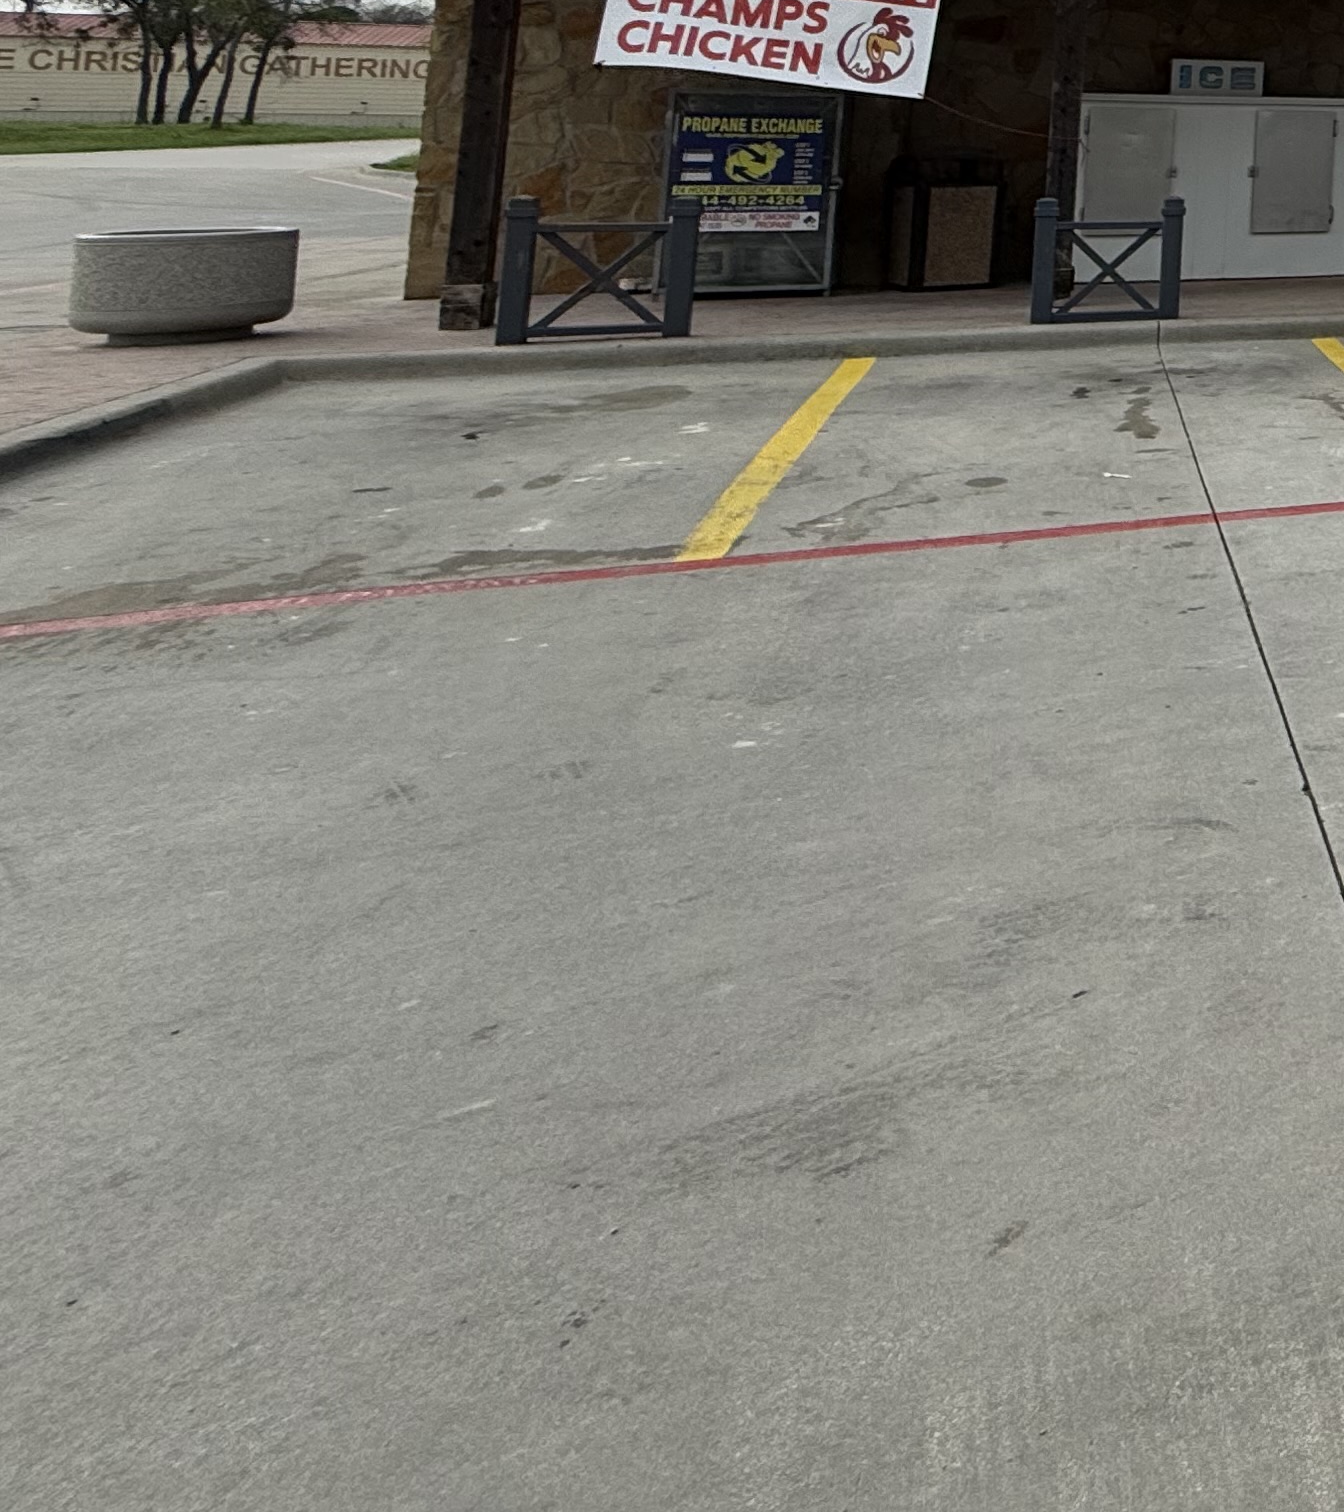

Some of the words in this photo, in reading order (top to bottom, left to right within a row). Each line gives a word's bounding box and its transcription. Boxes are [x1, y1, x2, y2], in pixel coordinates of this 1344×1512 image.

[616, 19, 824, 75] CHICKEN
[1179, 64, 1256, 90] ICE
[682, 116, 747, 133] PROPANE
[751, 118, 824, 134] EXCHANGE
[688, 186, 717, 195] HOUR
[719, 186, 778, 195] EMERGENCY
[780, 186, 820, 195] NUMBER
